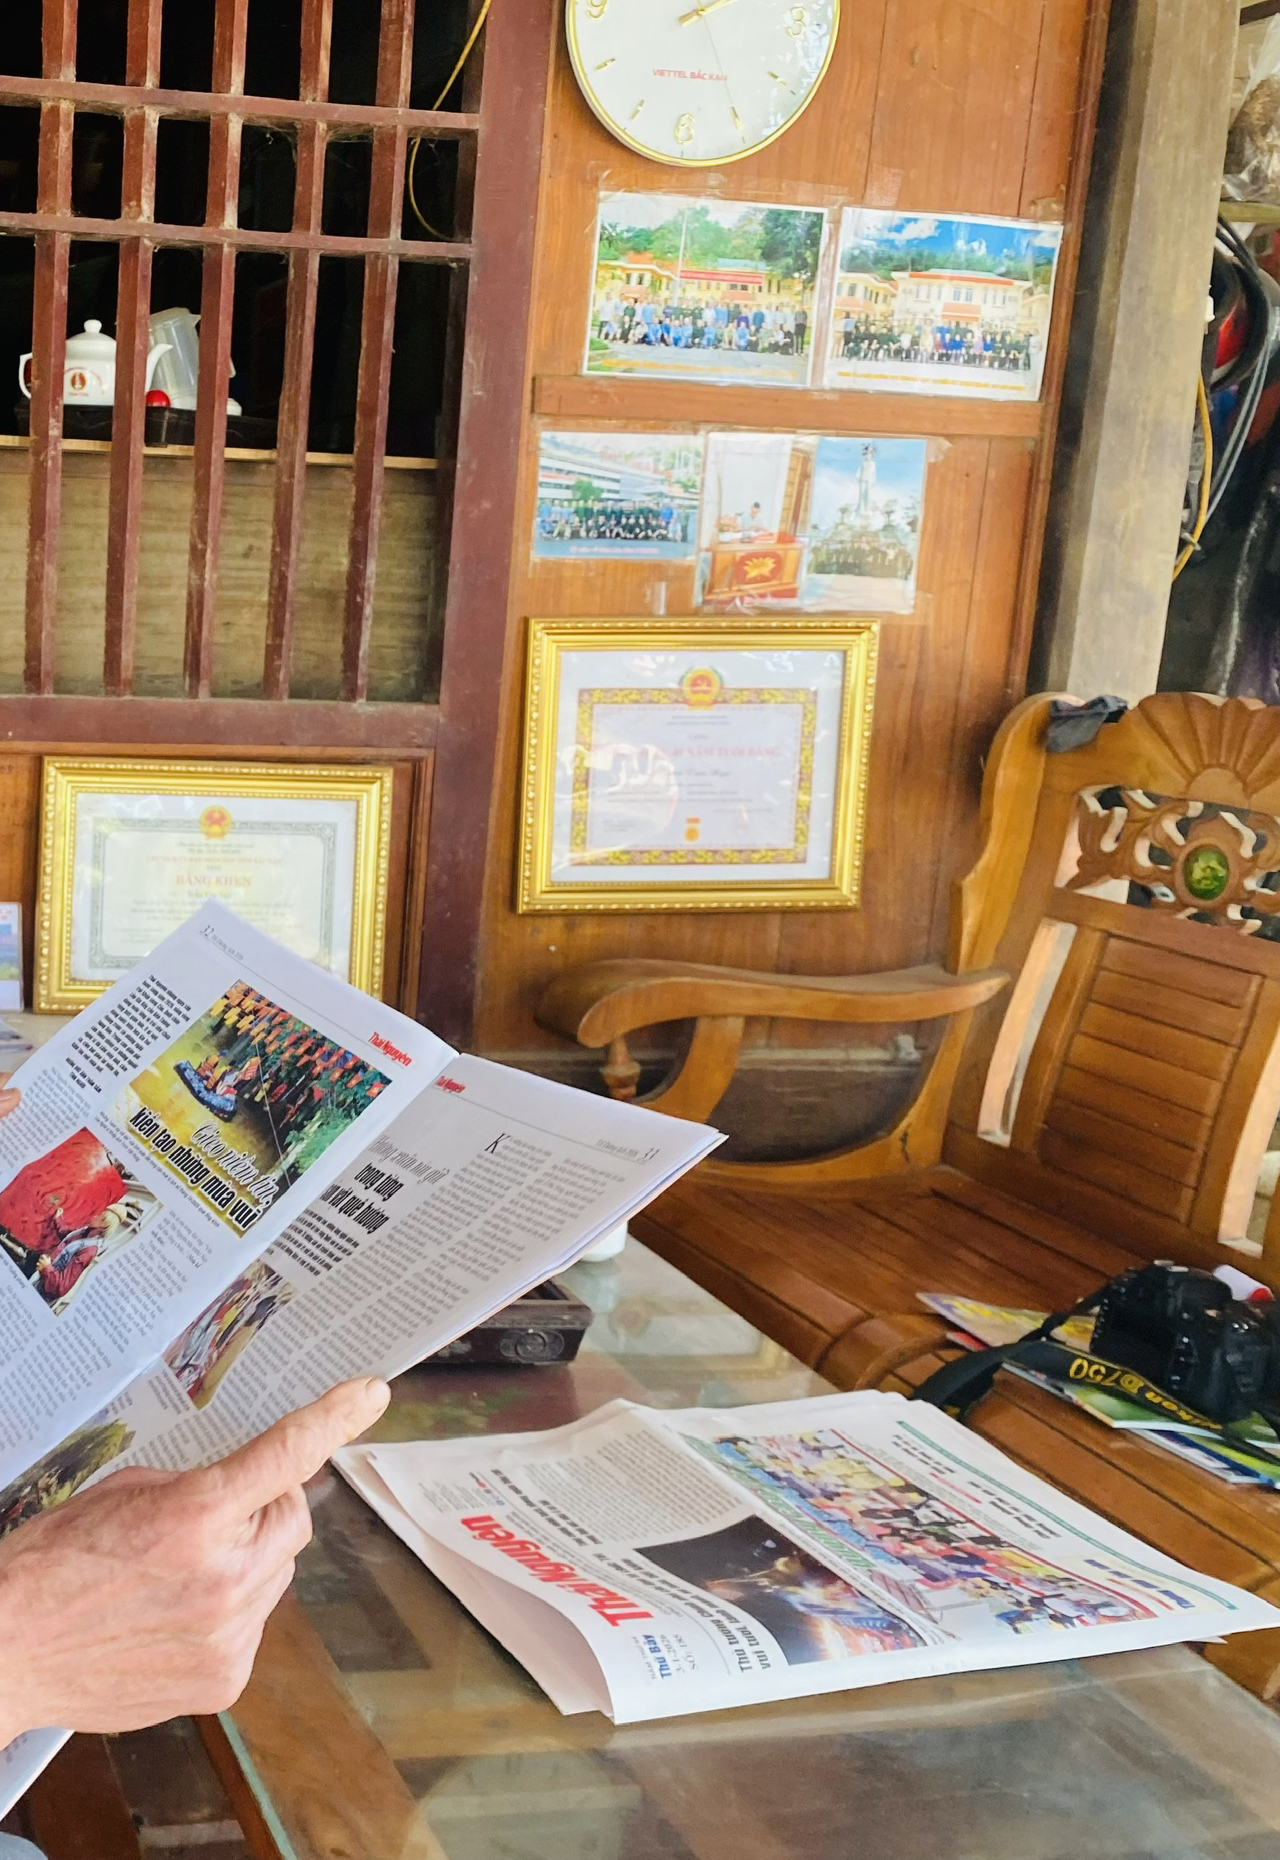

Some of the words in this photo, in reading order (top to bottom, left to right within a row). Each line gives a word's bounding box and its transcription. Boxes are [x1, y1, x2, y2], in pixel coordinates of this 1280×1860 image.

[653, 69, 689, 79] VIETTEL
[674, 113, 696, 145] 6
[214, 876, 252, 887] KHEN
[484, 1133, 511, 1154] K
[129, 1107, 161, 1138] kiến
[152, 1128, 177, 1152] tạo
[168, 1145, 211, 1185] những
[201, 1175, 236, 1209] mùa
[228, 1199, 262, 1229] vui
[192, 1123, 226, 1156] Gieo
[220, 1149, 259, 1184] niềm
[248, 1176, 279, 1206] tin,
[354, 1162, 386, 1191] trong
[373, 1173, 405, 1202] từng
[338, 1195, 370, 1218] quê
[353, 1202, 390, 1235] hương
[1069, 1358, 1146, 1394] D750
[460, 1515, 588, 1584] Nguyên
[556, 1580, 654, 1627] Thái
[639, 1634, 661, 1653] Bảy
[710, 1619, 740, 1646] tướng
[651, 1656, 673, 1678] Thứ
[734, 1647, 753, 1673] Thủ
[754, 1649, 772, 1671] vui
